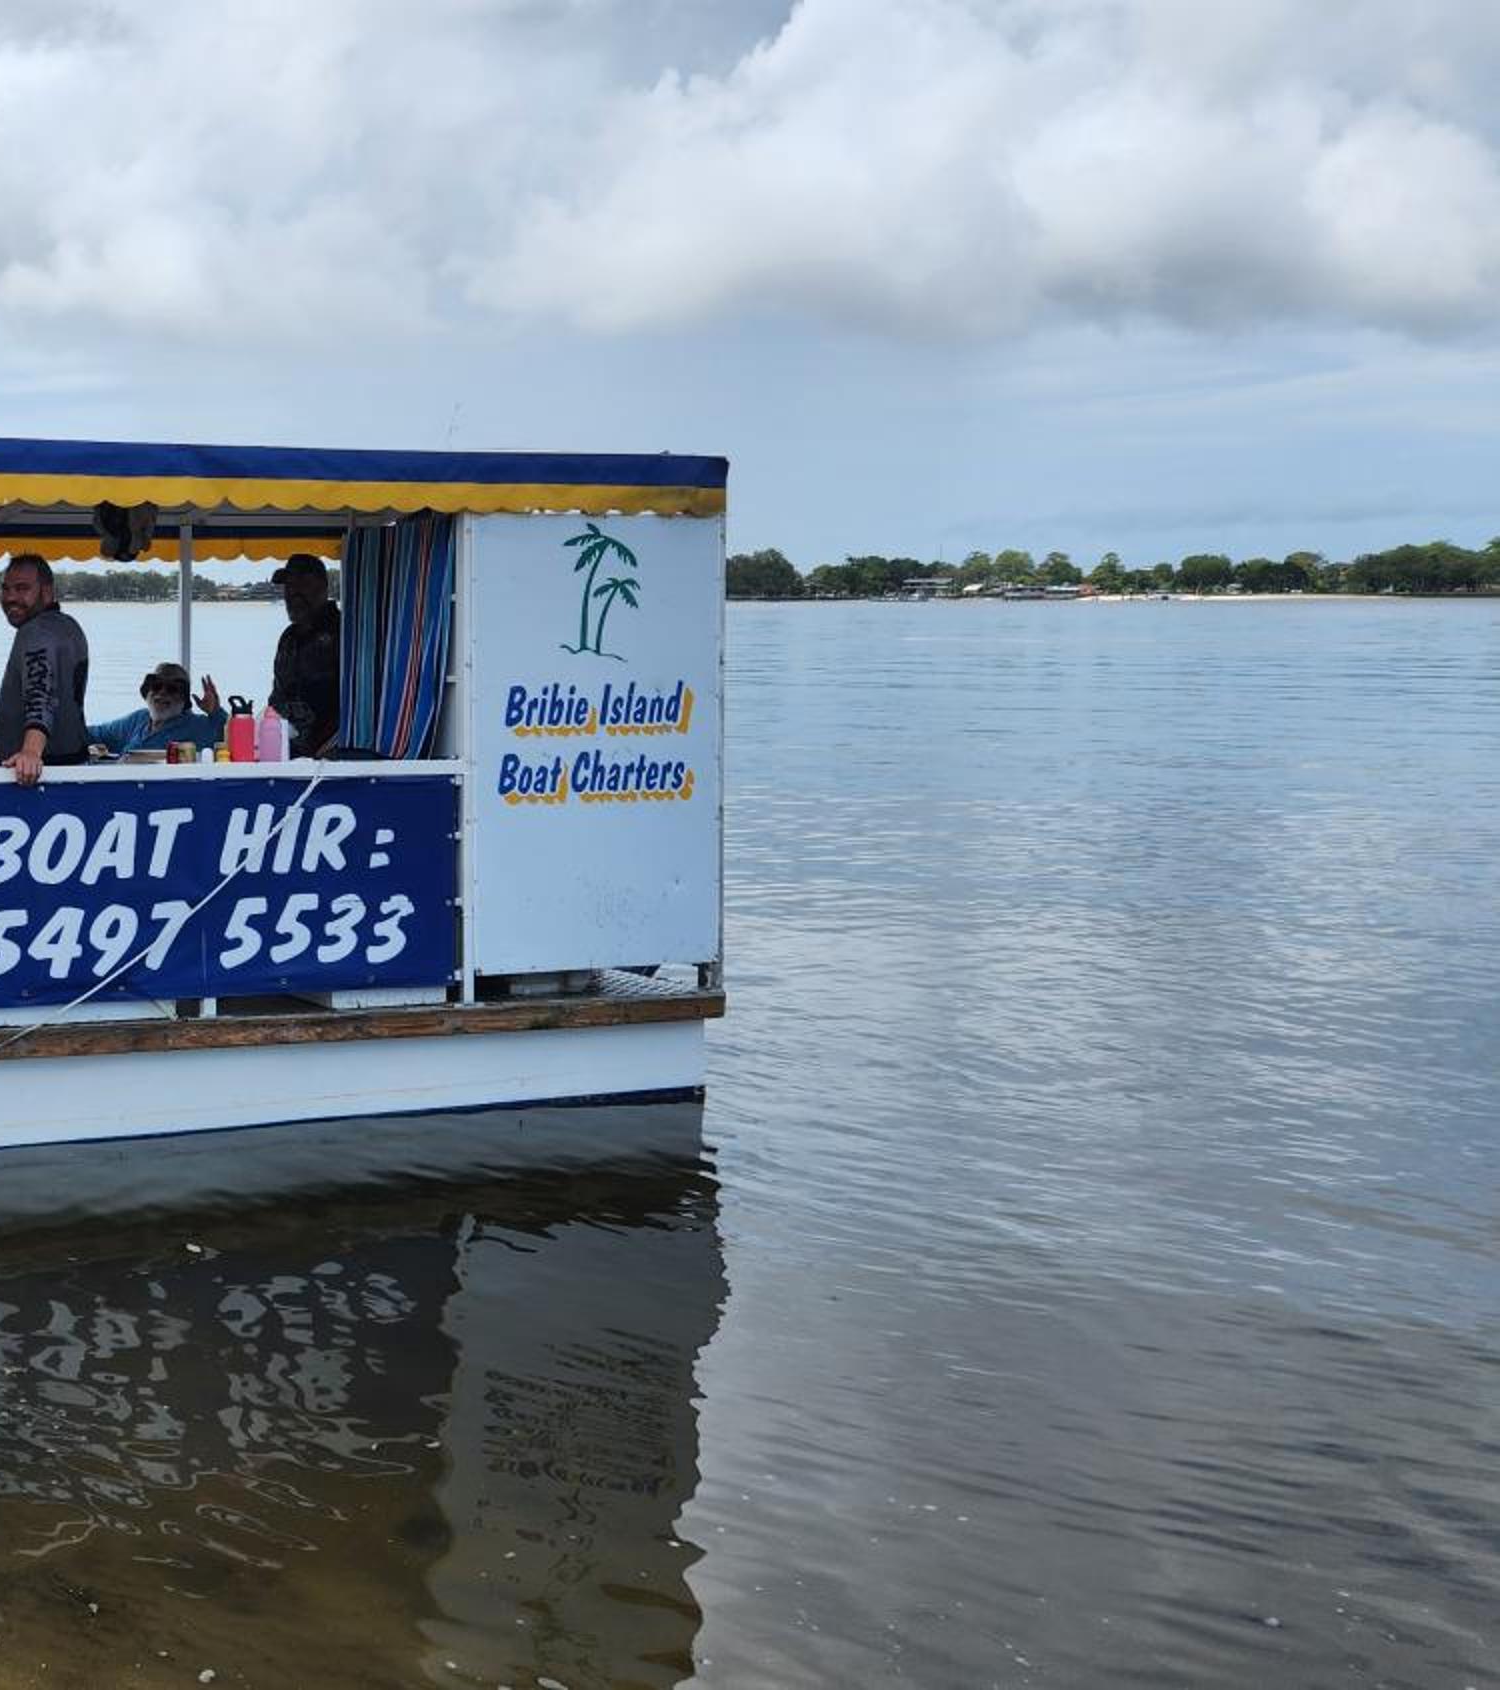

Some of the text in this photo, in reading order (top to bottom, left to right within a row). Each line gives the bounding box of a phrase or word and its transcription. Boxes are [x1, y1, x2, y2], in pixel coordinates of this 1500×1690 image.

[505, 680, 685, 727] Bribie Island
[498, 749, 685, 795] Boat Charters
[219, 894, 415, 969] 5533
